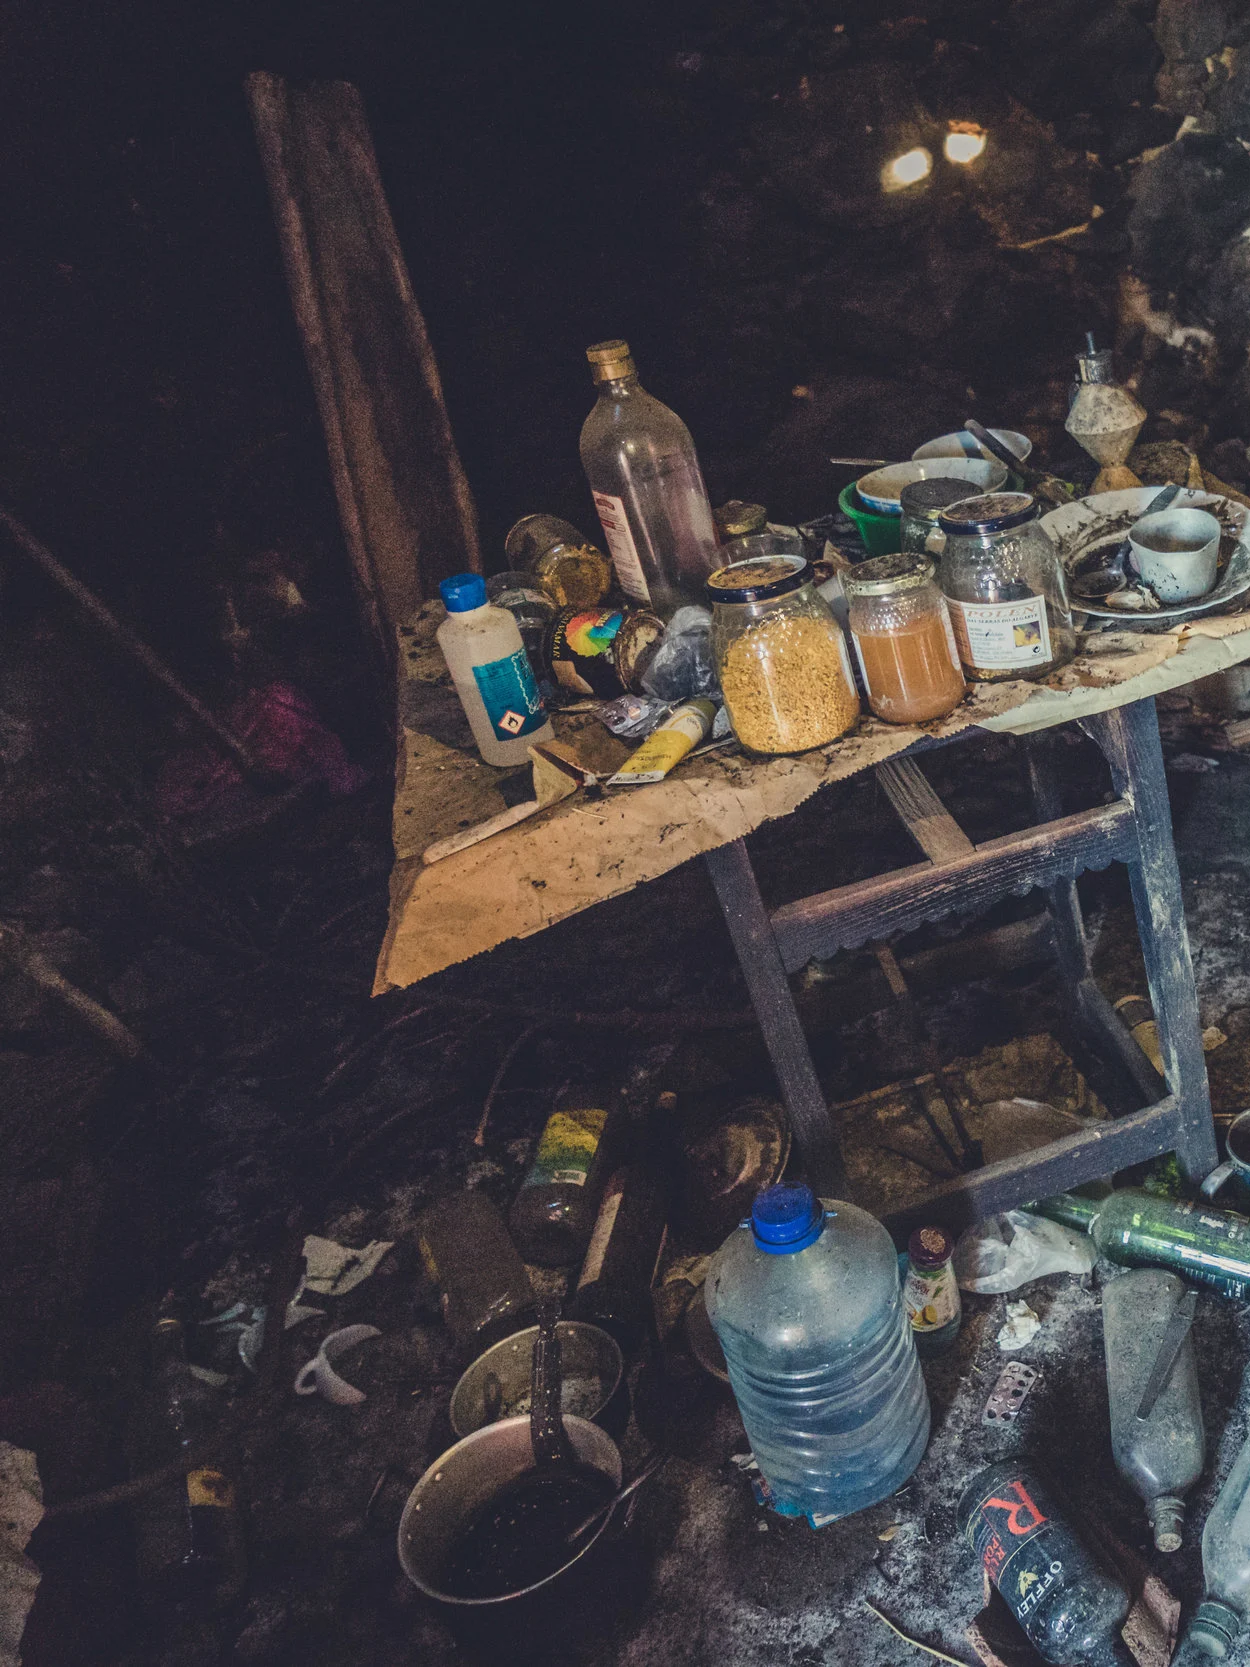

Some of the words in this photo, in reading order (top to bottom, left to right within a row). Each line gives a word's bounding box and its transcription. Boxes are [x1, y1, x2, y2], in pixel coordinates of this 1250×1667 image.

[967, 605, 1037, 618] POLEN
[982, 1480, 1050, 1535] R
[1016, 1561, 1062, 1619] OFFLEY
